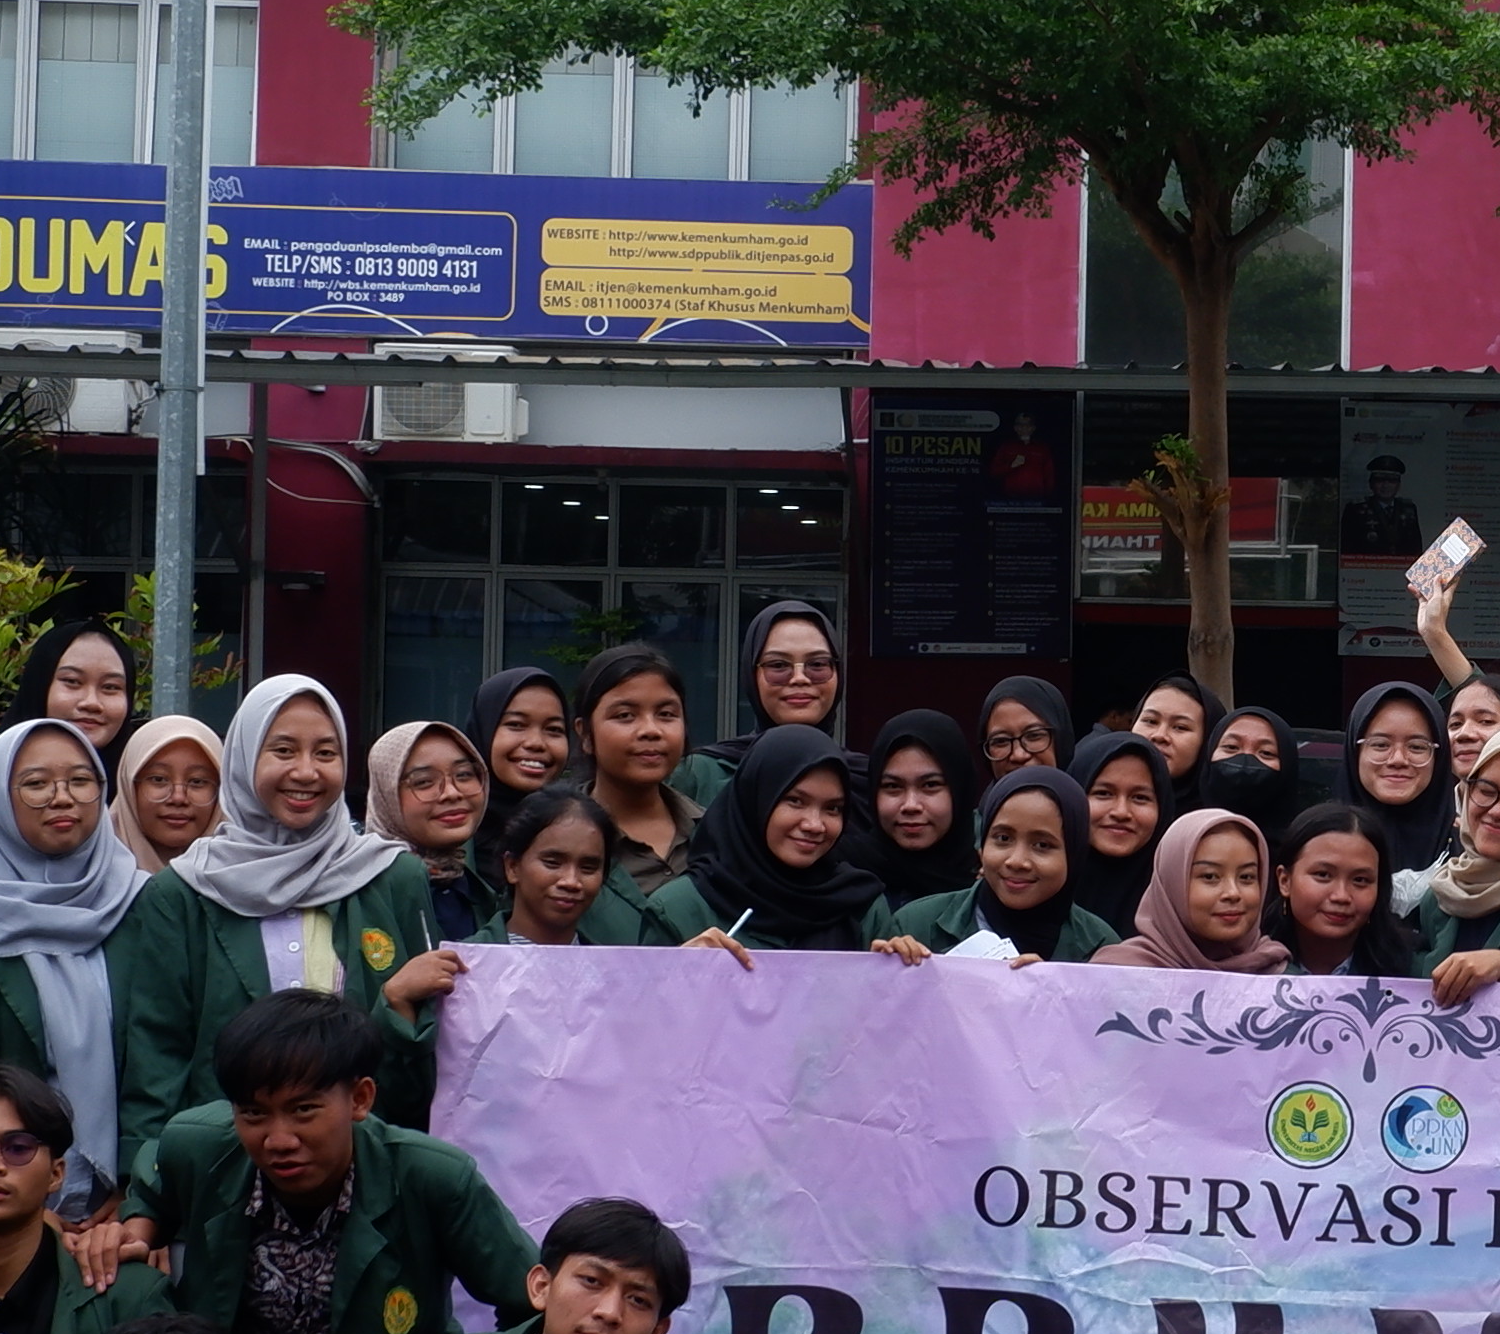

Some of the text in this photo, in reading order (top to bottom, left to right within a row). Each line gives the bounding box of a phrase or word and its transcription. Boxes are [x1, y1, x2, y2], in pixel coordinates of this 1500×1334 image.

[244, 238, 280, 250] EMAIL
[546, 228, 808, 248] WEBSITE http://www.kemenkumham.go.id
[609, 246, 834, 265] http://www.sdppublik.ditjenpas.go.id
[265, 254, 478, 279] TELP/SMS 0813 9009 4131
[252, 277, 481, 294] WEBSITE http://wbs.kemenkumham.go.id
[545, 280, 777, 299] EMAIL itjen@kemenkumham.go.id
[327, 291, 405, 303] PO BOX 3489
[543, 296, 850, 317] SMS 08111000374 (Staf Khusus Menkumham)
[911, 436, 981, 455] PESAN
[974, 1165, 1458, 1248] OBSERVASI
